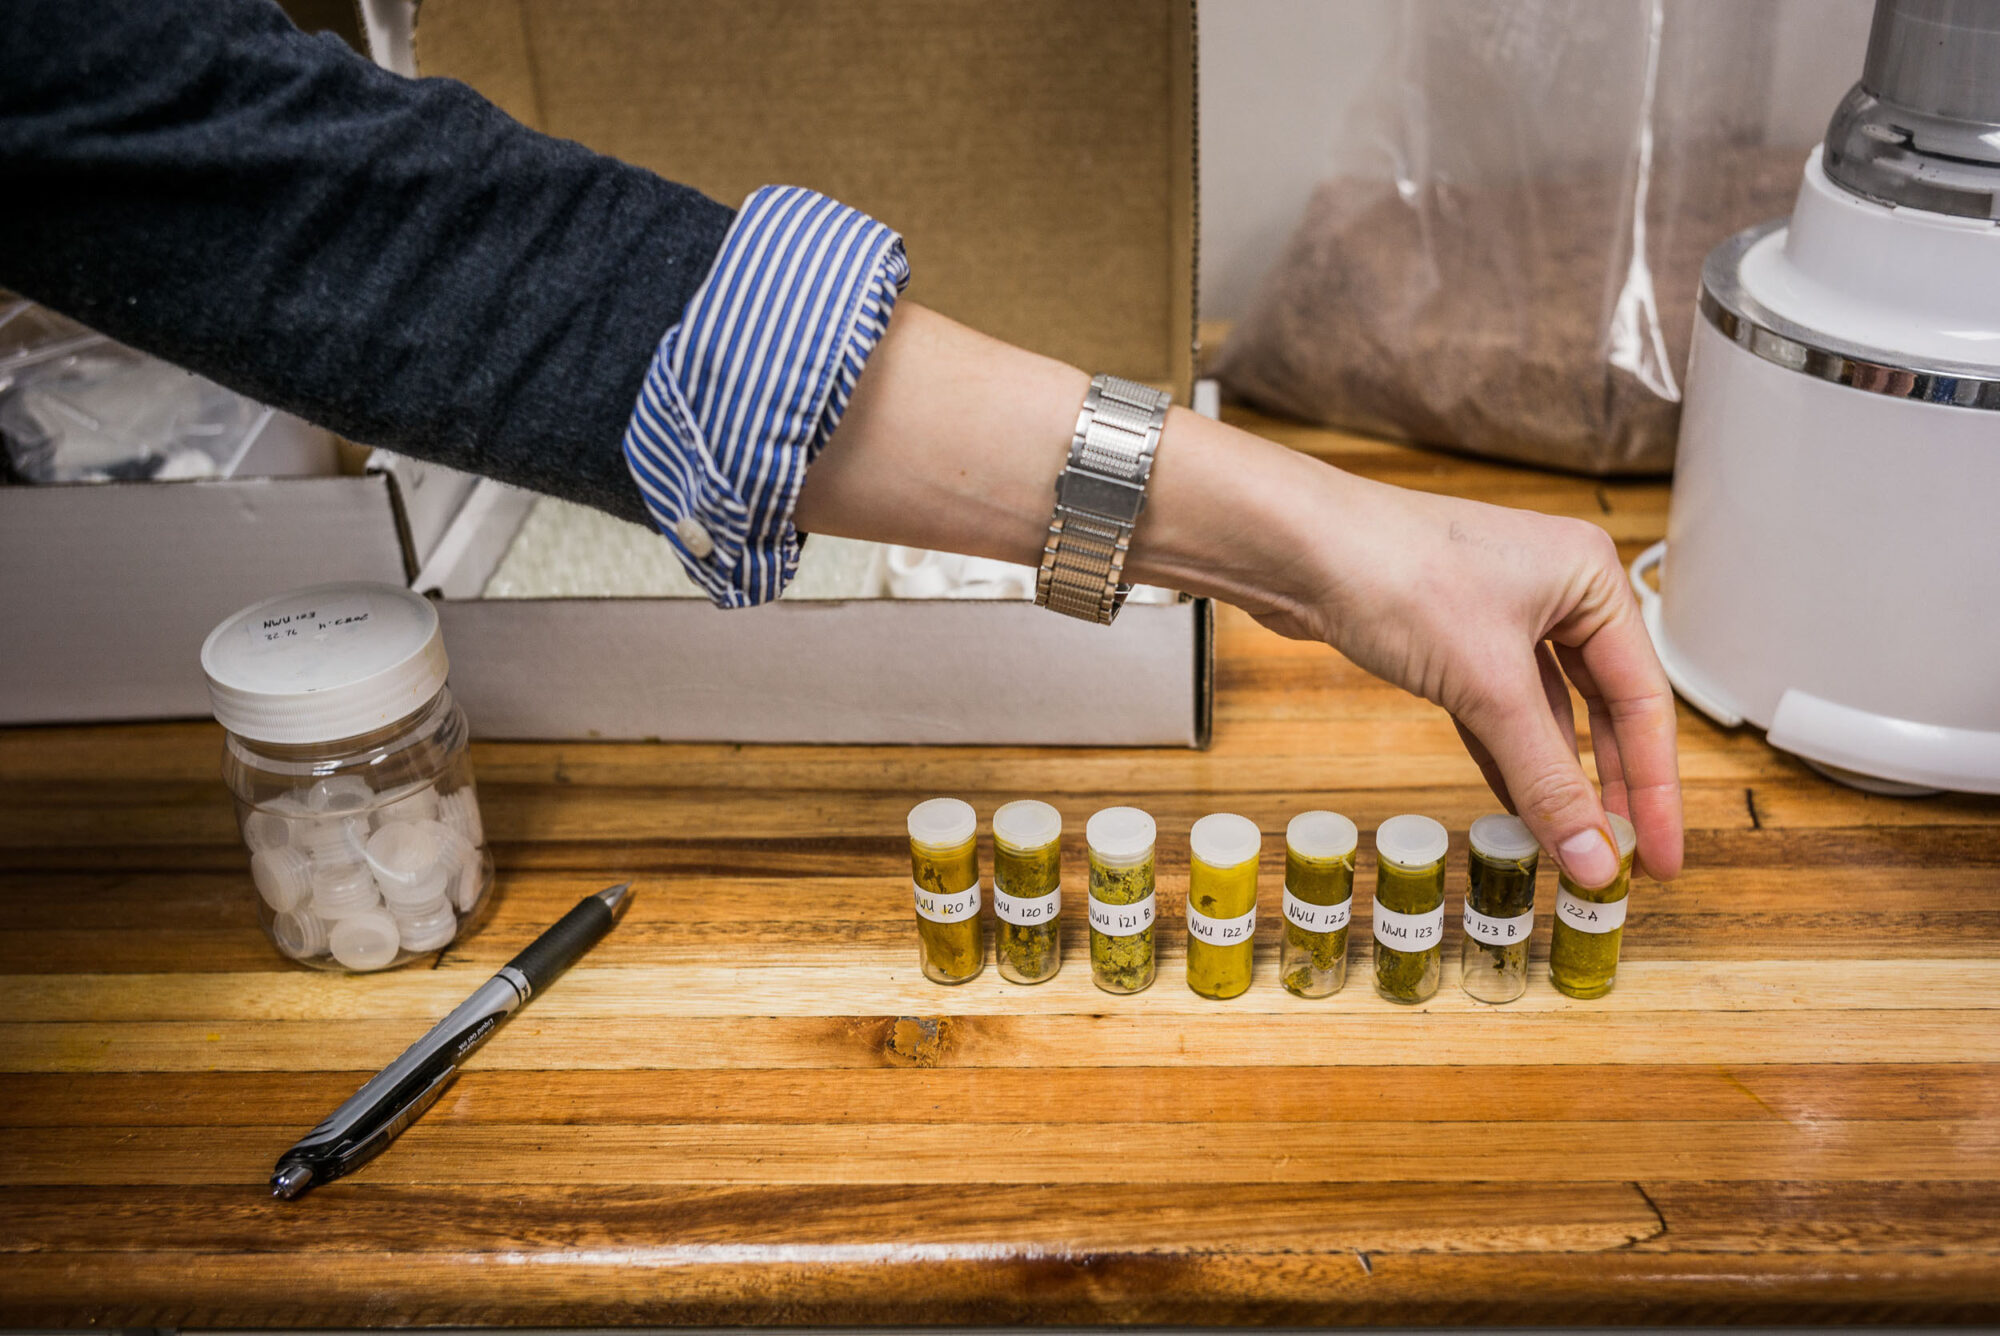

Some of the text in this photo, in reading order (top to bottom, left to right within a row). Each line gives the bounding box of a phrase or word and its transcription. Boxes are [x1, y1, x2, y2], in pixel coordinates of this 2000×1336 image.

[263, 616, 291, 629] NWU
[943, 902, 964, 914] 120
[1021, 908, 1041, 918] 120
[1289, 902, 1345, 925] NWU 122
[1191, 917, 1213, 937] NWU
[1223, 927, 1242, 938] 122
[1382, 920, 1407, 939] NWU
[1415, 926, 1433, 938] 123
[1477, 922, 1499, 936] 123
